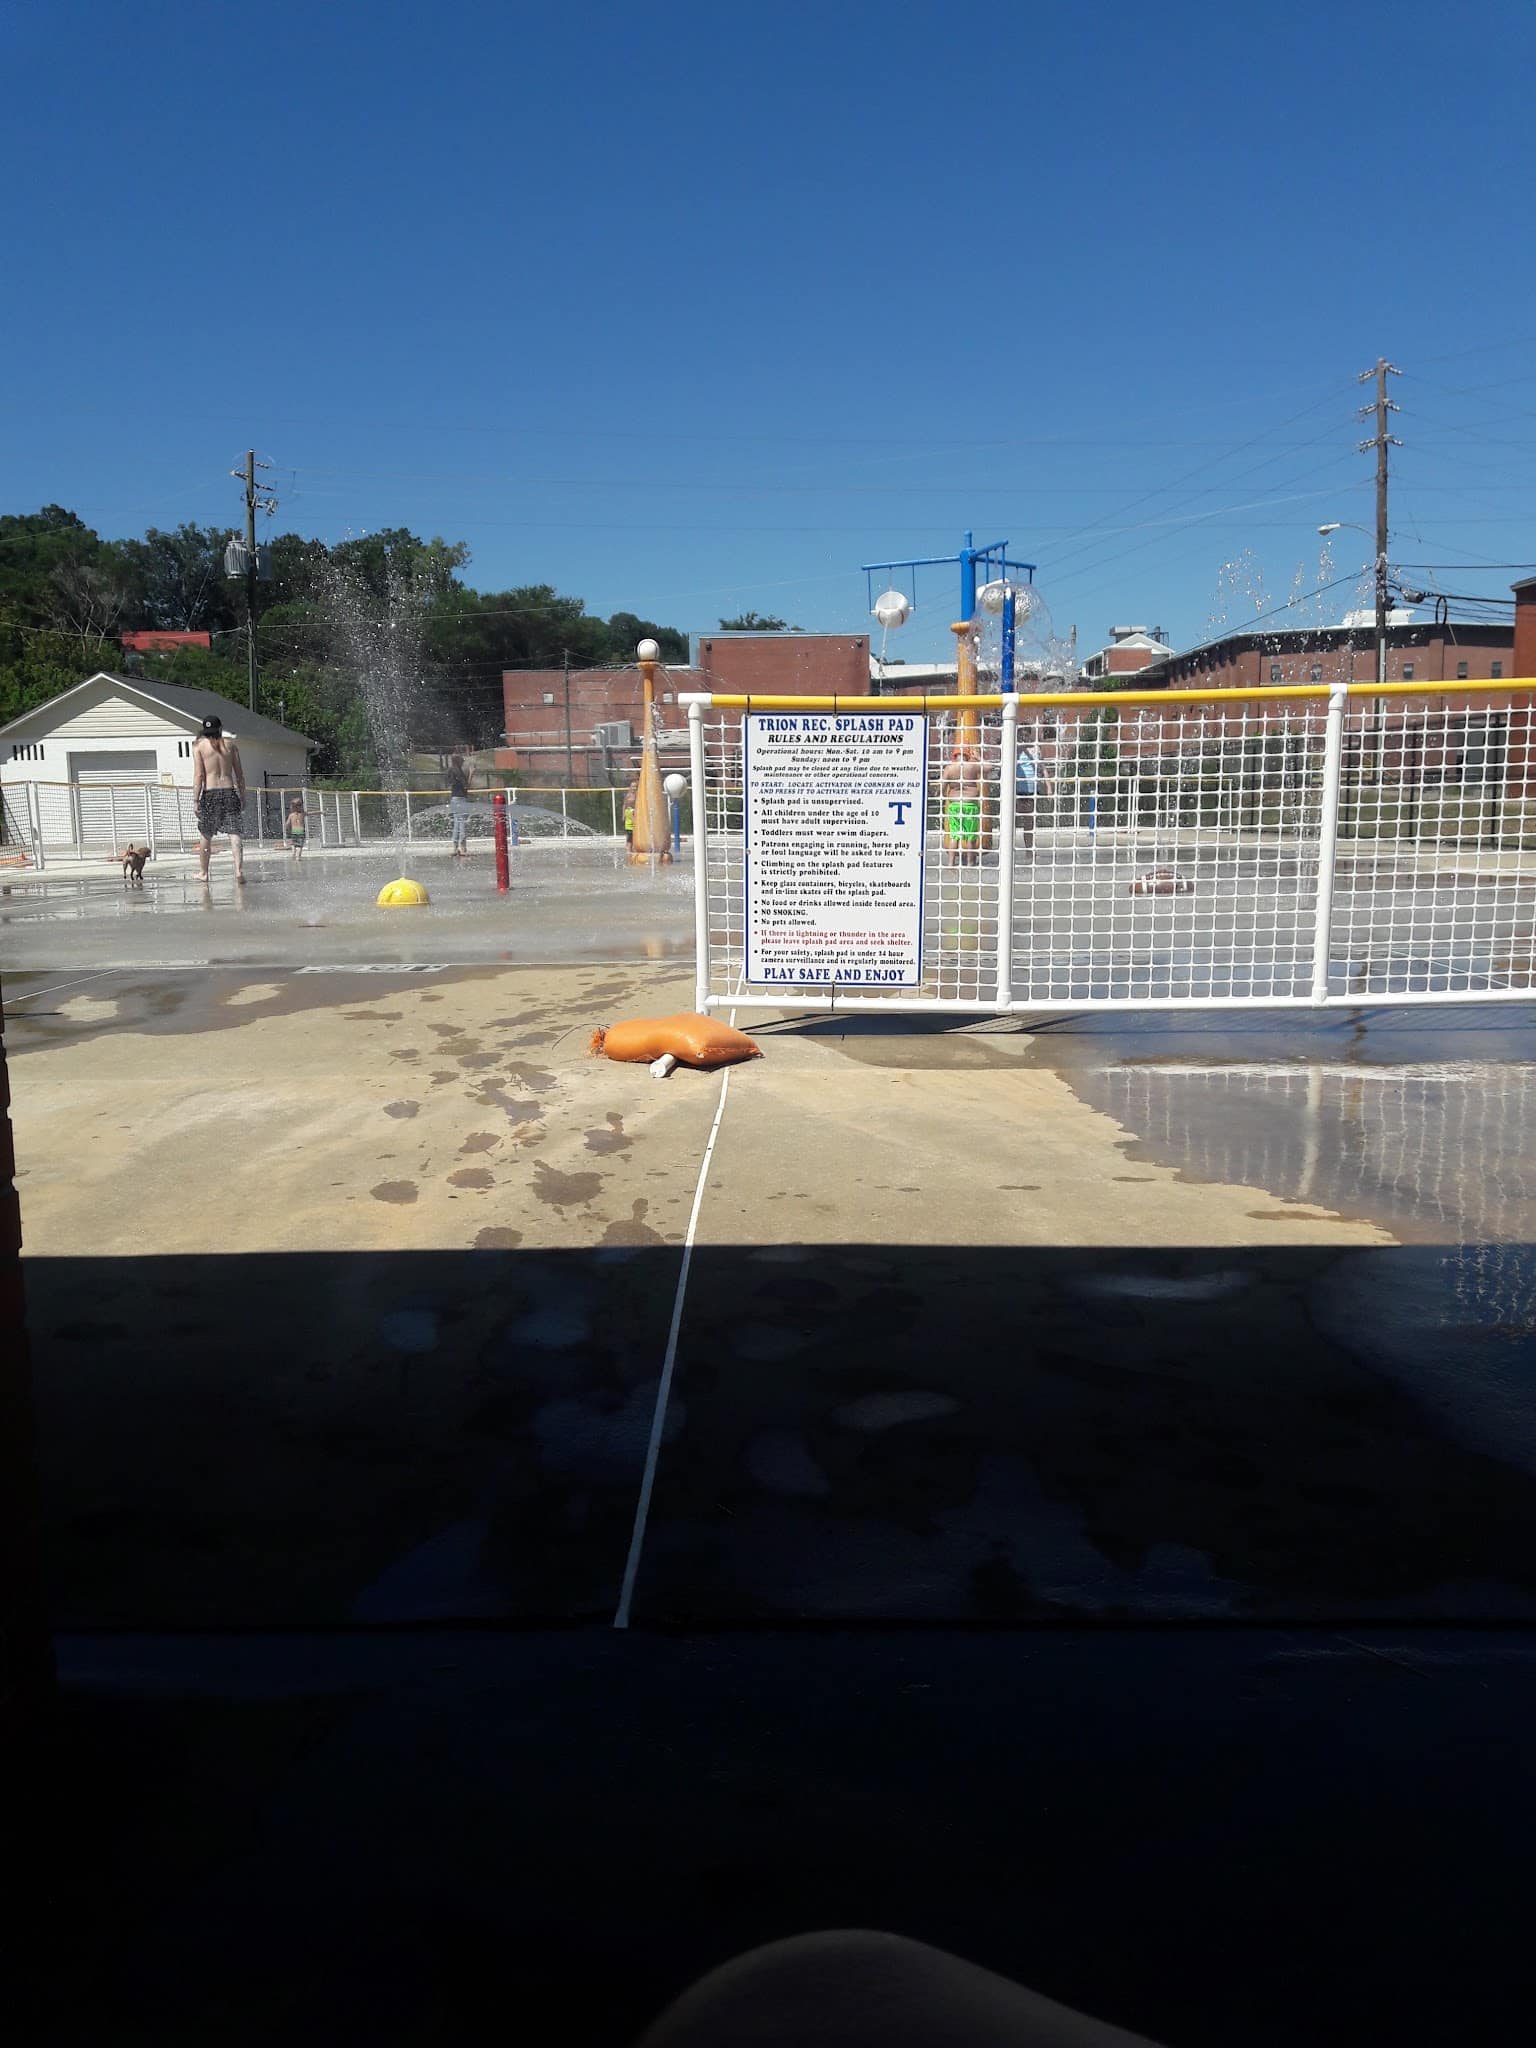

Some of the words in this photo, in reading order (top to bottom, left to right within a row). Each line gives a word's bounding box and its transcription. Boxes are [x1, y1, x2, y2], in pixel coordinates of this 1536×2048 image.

[759, 719, 797, 731] TRION
[802, 719, 830, 731] REC.
[835, 718, 883, 731] SPLASH
[889, 719, 913, 731] PAD
[768, 735, 801, 743] RULES
[804, 735, 827, 743] AND
[830, 735, 904, 743] REGULATIONS
[756, 748, 798, 756] Operational
[760, 798, 784, 806] Splash
[788, 798, 800, 806] pad
[812, 798, 863, 806] unsupervised.
[762, 808, 772, 816] All
[889, 802, 911, 825] T
[823, 818, 868, 826] supervision.
[760, 828, 792, 836] Toddlers
[792, 841, 824, 849] engaging
[837, 841, 869, 849] running,
[894, 842, 910, 850] play
[789, 849, 820, 857] language
[761, 860, 794, 868] Climbing
[822, 860, 844, 868] splash
[846, 862, 860, 870] pad
[770, 868, 796, 876] strictly
[760, 880, 778, 888] Keep
[780, 880, 796, 888] glass
[848, 888, 870, 896] splash
[796, 930, 828, 938] lightning
[802, 938, 822, 946] splash
[824, 938, 838, 946] pad
[791, 949, 812, 957] safety,
[814, 950, 834, 958] splash
[836, 950, 848, 958] pad
[848, 958, 878, 966] regularly
[764, 968, 795, 980] PLAY
[799, 968, 830, 980] SAFE
[835, 969, 861, 980] AND
[865, 969, 904, 981] ENJOY
